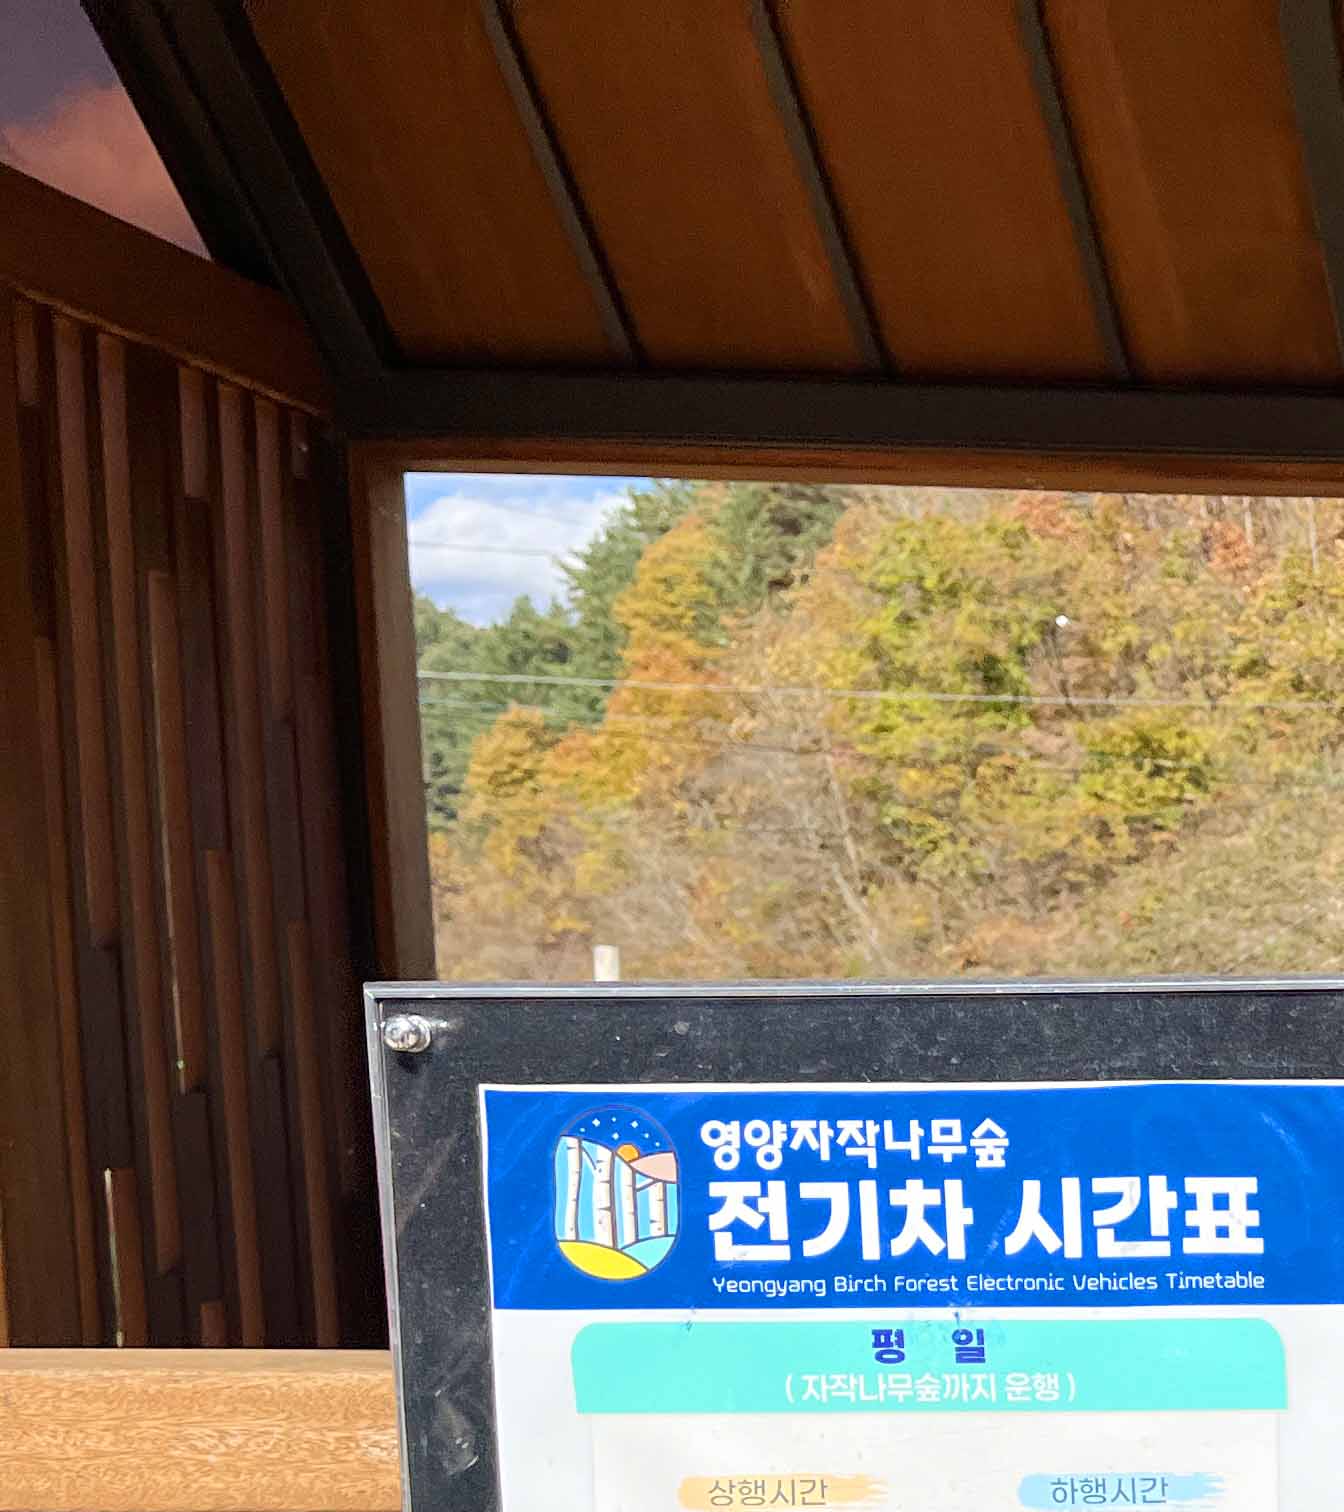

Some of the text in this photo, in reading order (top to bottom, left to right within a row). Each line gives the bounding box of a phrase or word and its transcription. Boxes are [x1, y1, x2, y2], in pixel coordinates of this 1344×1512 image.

[701, 1119, 1010, 1169] 영양자작나무숲
[708, 1175, 1264, 1261] 전기차 시간표
[712, 1272, 1264, 1296] Yeongyang Birch Forest Electronic Vehicles Timetable
[707, 1478, 829, 1507] 상행시간
[1051, 1477, 1169, 1506] 하행시간
